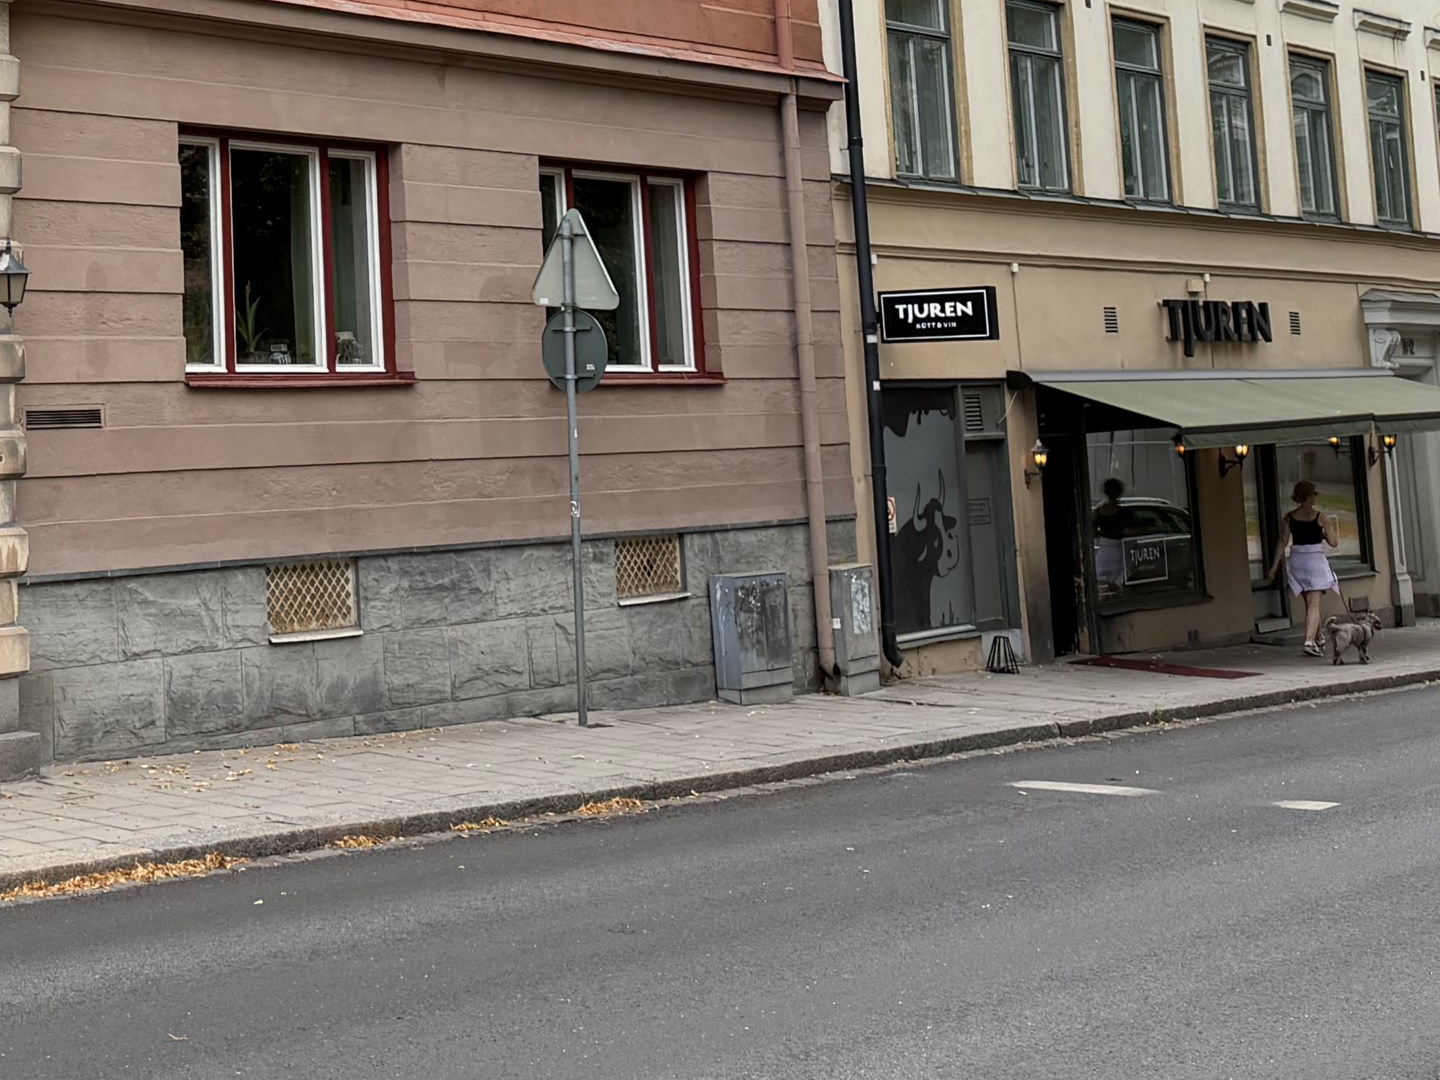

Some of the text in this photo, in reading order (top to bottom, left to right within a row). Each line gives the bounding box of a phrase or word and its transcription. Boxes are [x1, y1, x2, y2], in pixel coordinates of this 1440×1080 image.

[894, 300, 973, 324] TJUREN
[1162, 298, 1273, 358] TJUREN
[1130, 547, 1160, 565] TJUREN
